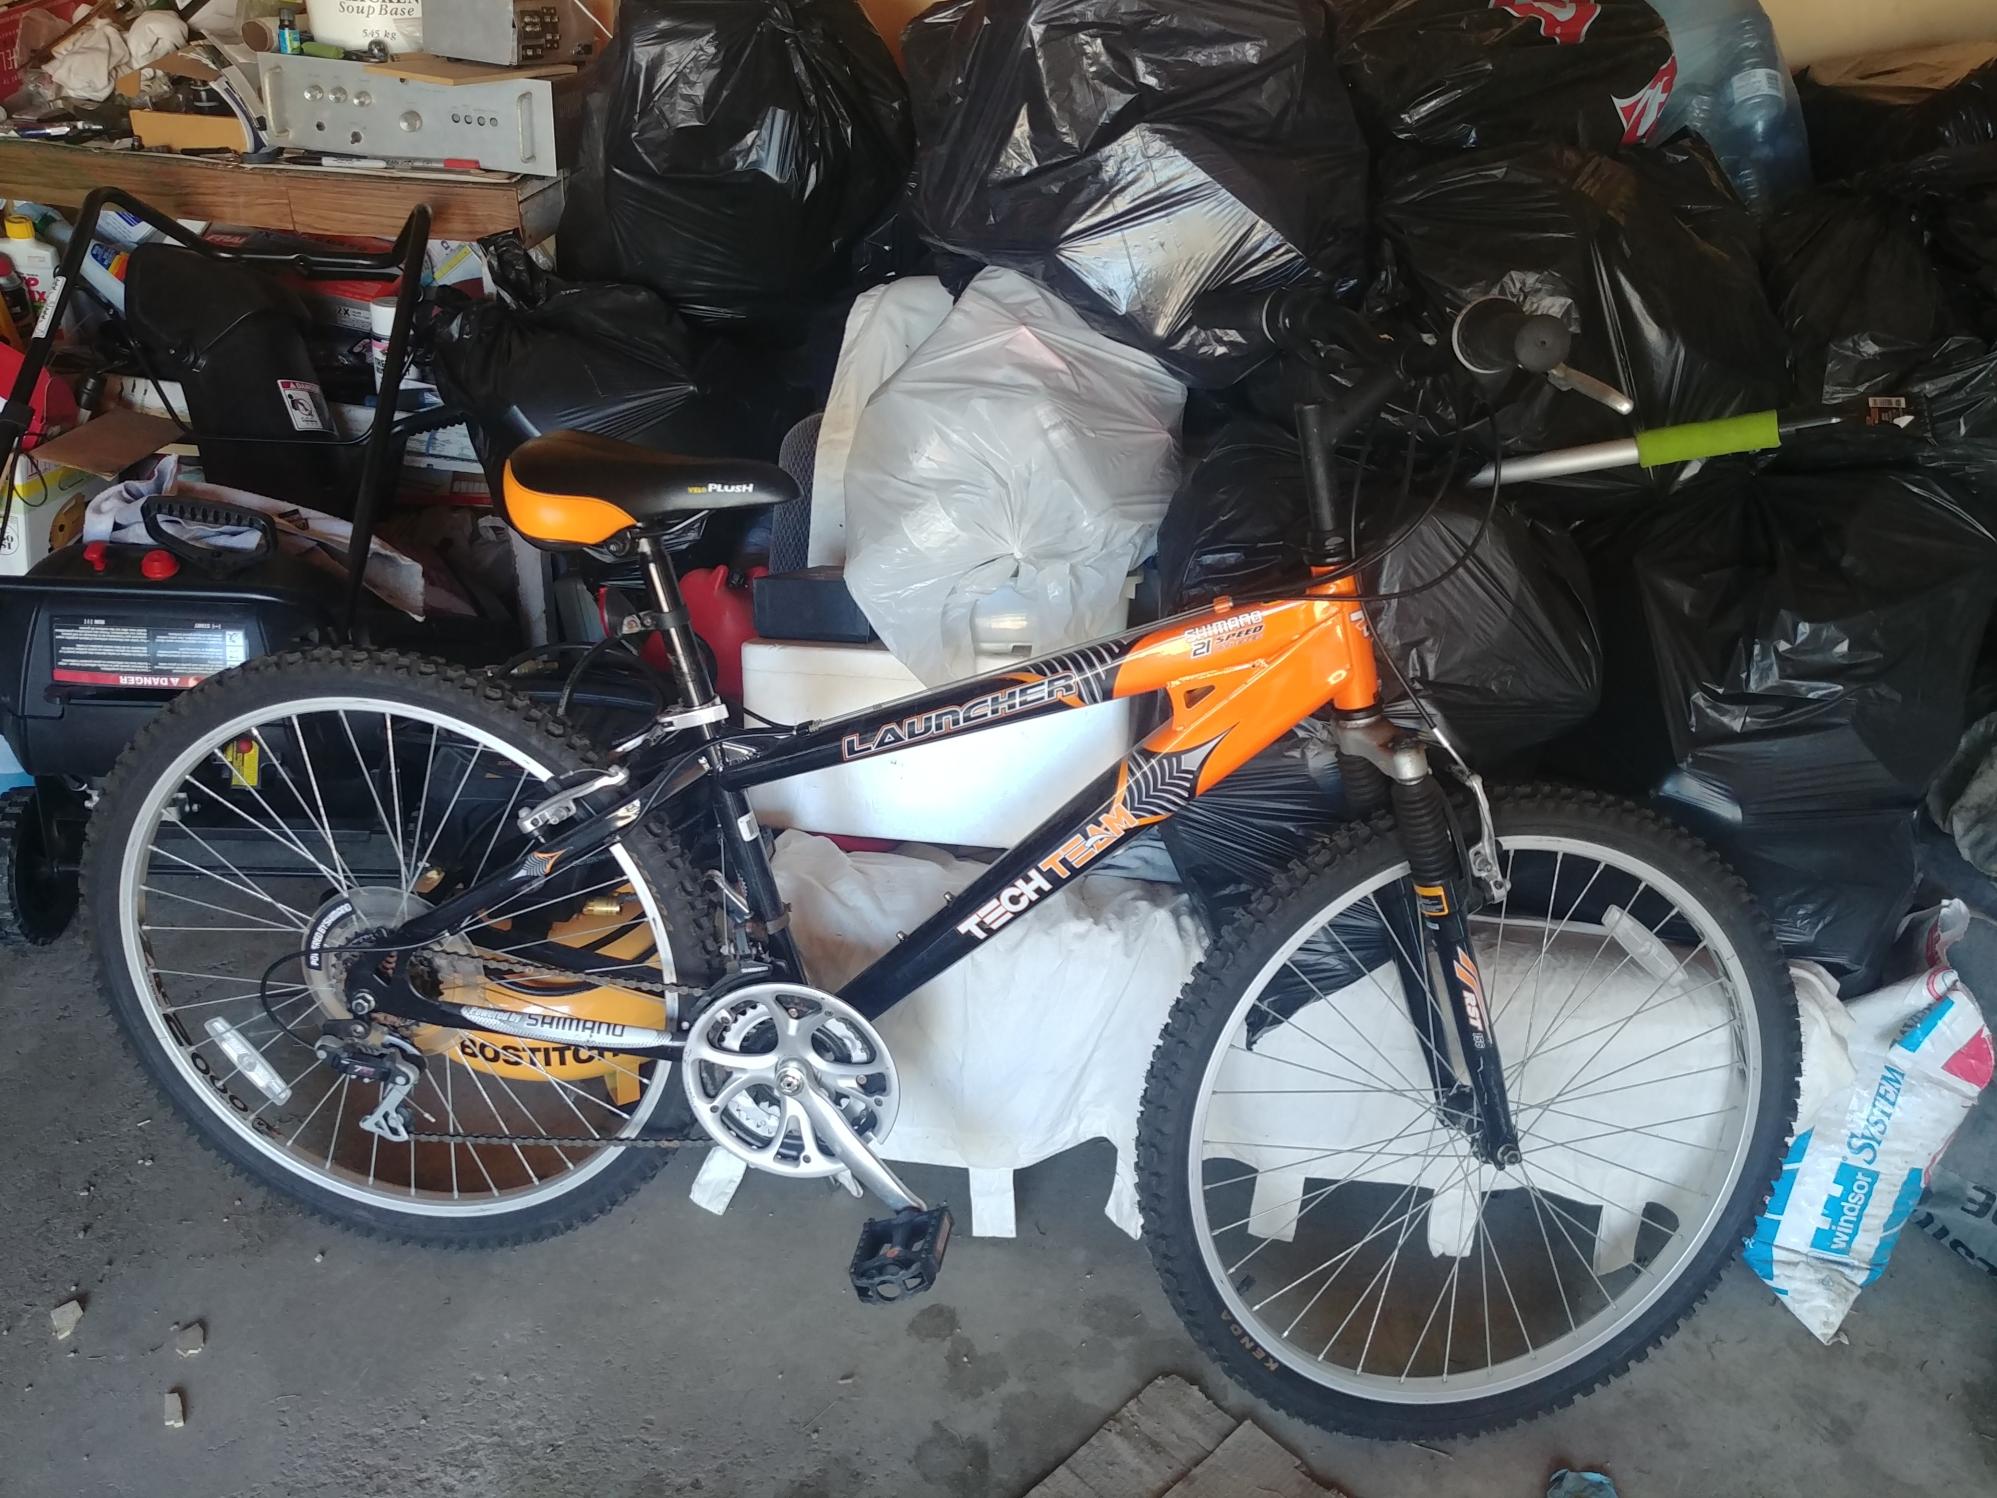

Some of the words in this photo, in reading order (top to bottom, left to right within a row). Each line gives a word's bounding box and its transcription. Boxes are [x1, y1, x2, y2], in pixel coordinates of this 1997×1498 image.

[339, 2, 376, 18] Soup
[378, 4, 415, 16] Base
[384, 29, 397, 41] kg
[708, 483, 754, 493] PLUSH
[1184, 610, 1263, 642] SHIMANO
[1192, 638, 1211, 658] 21
[1216, 624, 1264, 643] SPEED
[119, 674, 168, 687] DANGER
[842, 671, 1079, 761] LAUNCHER
[956, 868, 1053, 940] TECH
[1037, 803, 1138, 879] TEAM
[526, 1013, 626, 1038] SHIMANO
[1462, 989, 1483, 1032] RST
[1846, 1064, 1905, 1165] SYSTEM
[1831, 1171, 1873, 1249] windsor
[1221, 1309, 1280, 1371] KENDA
